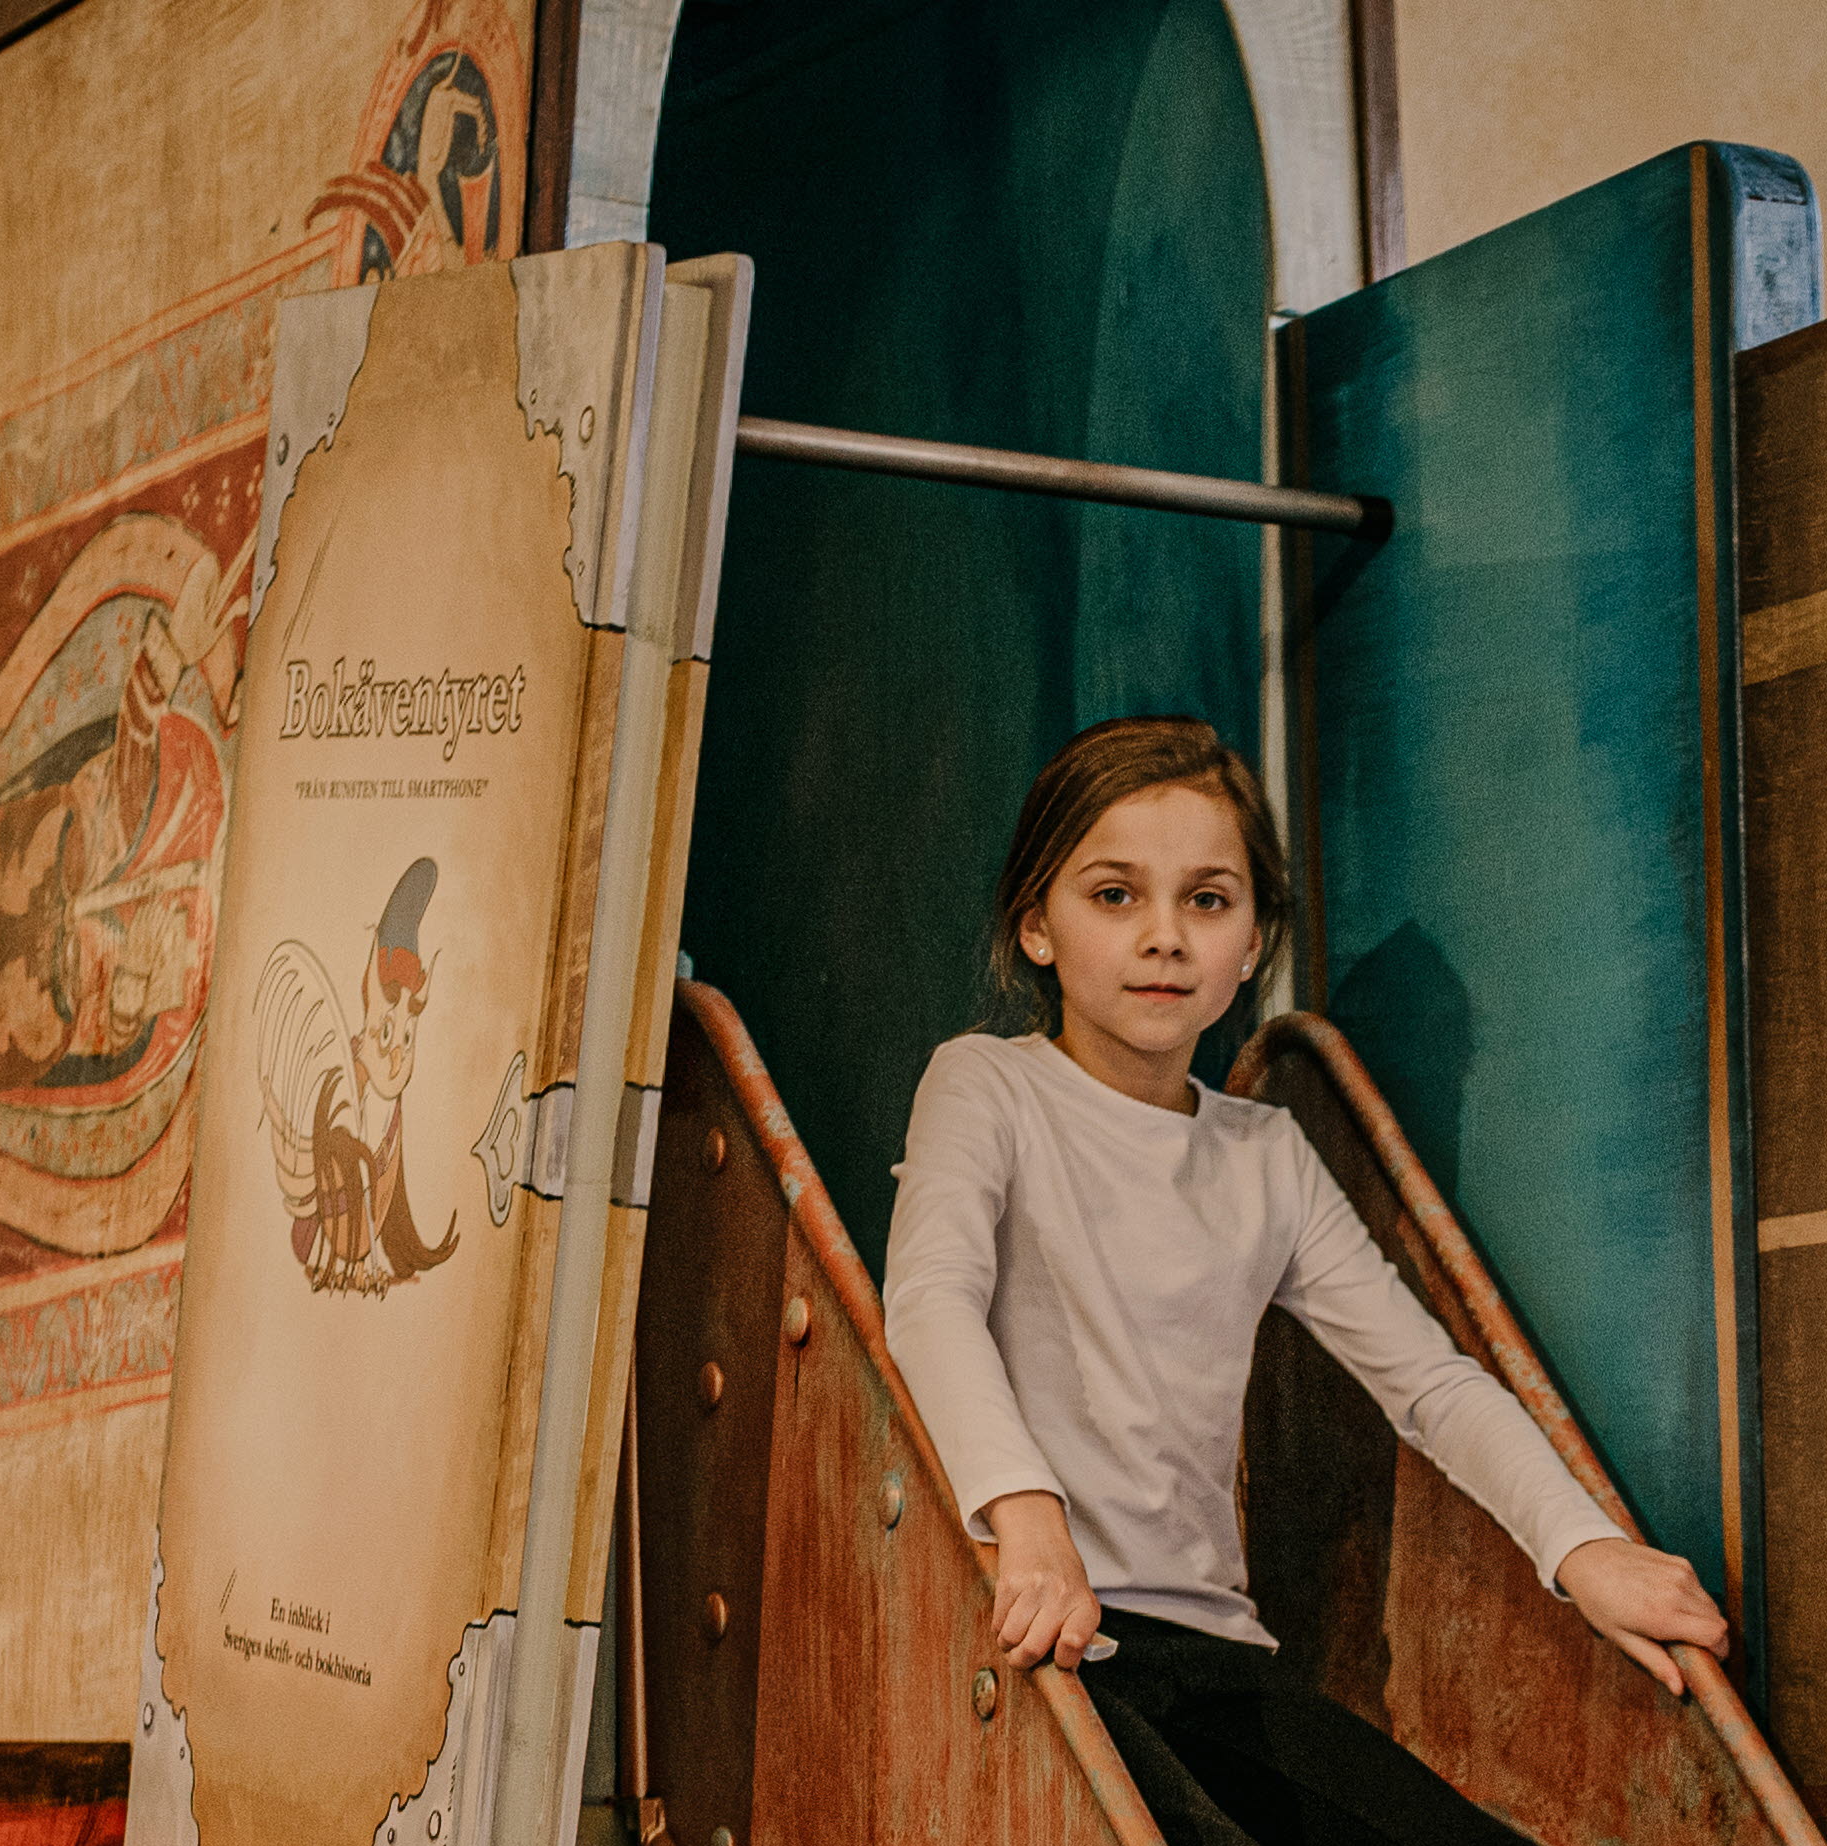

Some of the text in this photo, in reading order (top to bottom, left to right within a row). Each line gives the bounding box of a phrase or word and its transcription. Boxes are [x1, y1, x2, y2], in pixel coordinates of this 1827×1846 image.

[278, 656, 527, 762] Bokäventyret
[380, 778, 405, 799] TILL
[270, 1597, 331, 1635] En inblick i
[223, 1623, 372, 1687] Sveriges skrift- och bokhistoria
